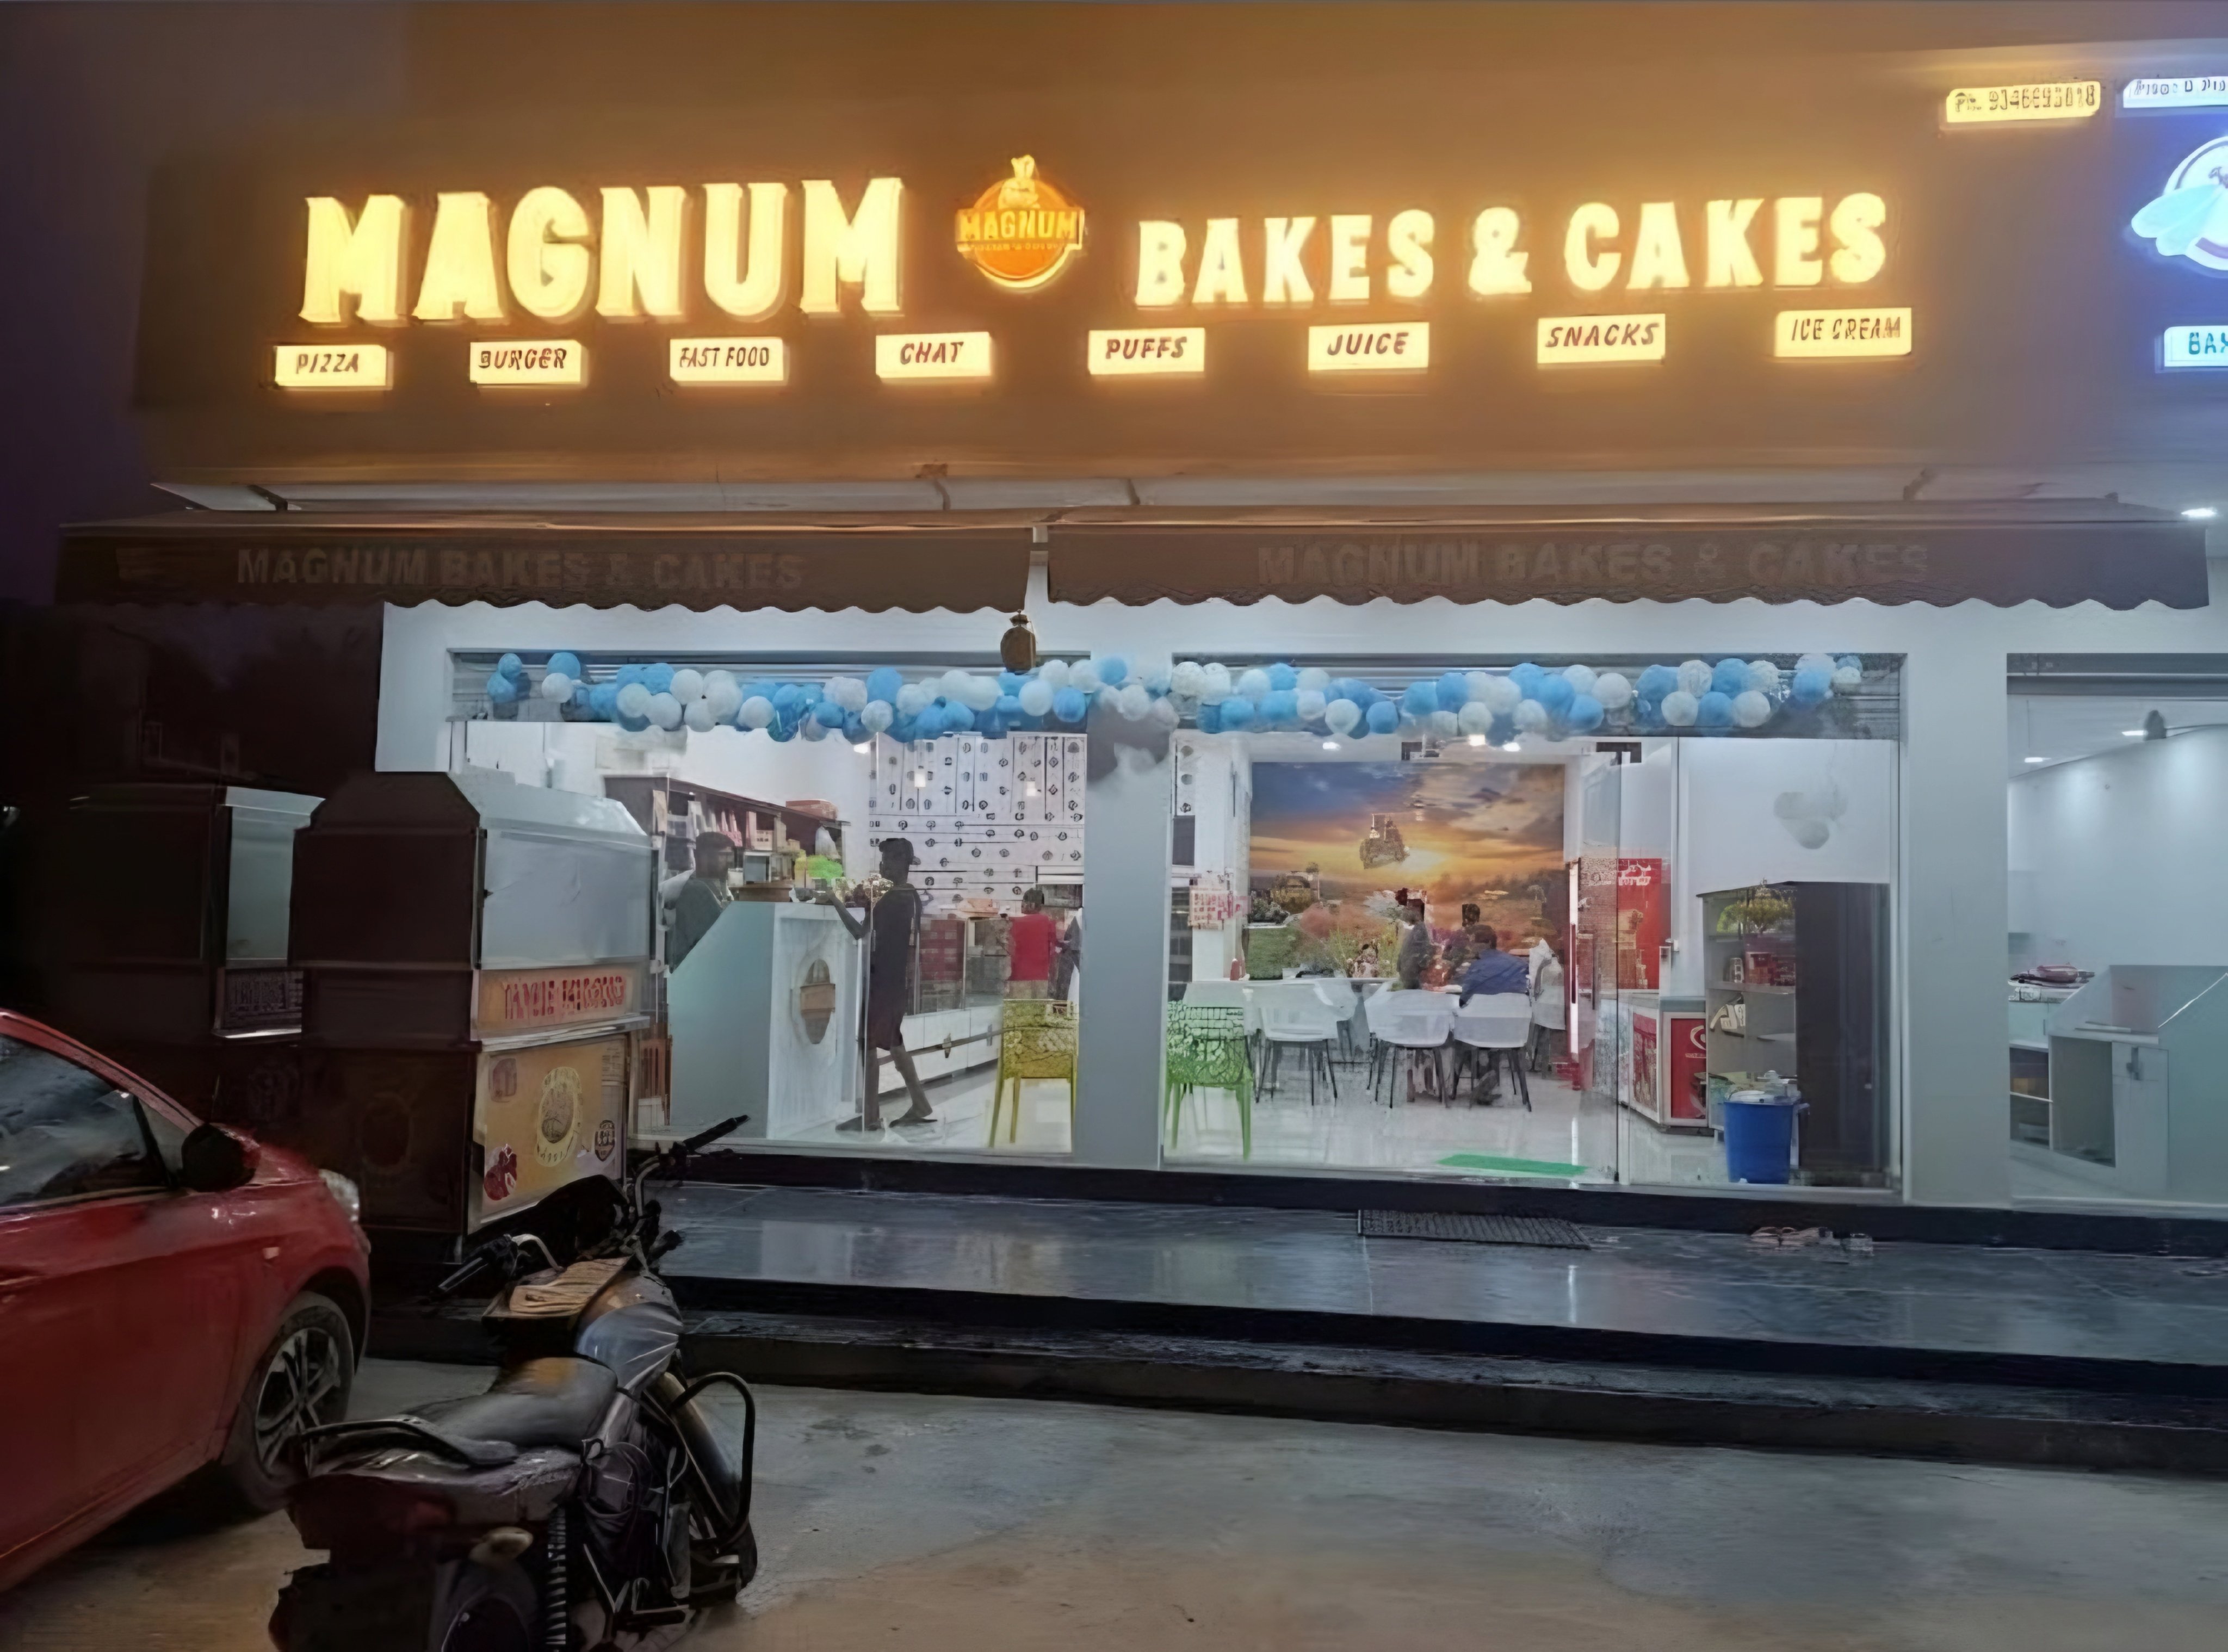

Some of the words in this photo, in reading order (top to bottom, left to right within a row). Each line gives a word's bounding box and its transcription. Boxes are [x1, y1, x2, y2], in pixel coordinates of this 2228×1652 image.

[960, 209, 1078, 241] MAGNUM
[299, 177, 903, 322] MAGNUM
[1135, 209, 1434, 306] BAKES
[1469, 206, 1532, 295] &
[1564, 193, 1886, 290] CAKES
[1545, 321, 1661, 348] SNACKS
[1791, 318, 1824, 341] ICE
[1832, 316, 1901, 341] CREAM
[900, 341, 964, 365] CHAT
[1105, 336, 1187, 360] PUFFS
[1326, 331, 1410, 356] JUICE
[295, 353, 359, 374] PIZZA
[478, 348, 567, 370] BURGER
[679, 347, 720, 368] FAST
[725, 345, 770, 367] FOOD
[238, 548, 426, 585] MAGNUM
[440, 550, 588, 587] BAKES
[653, 552, 804, 588] CAKES
[1258, 543, 1480, 584] MAGNUM
[1500, 543, 1672, 582] BAKES
